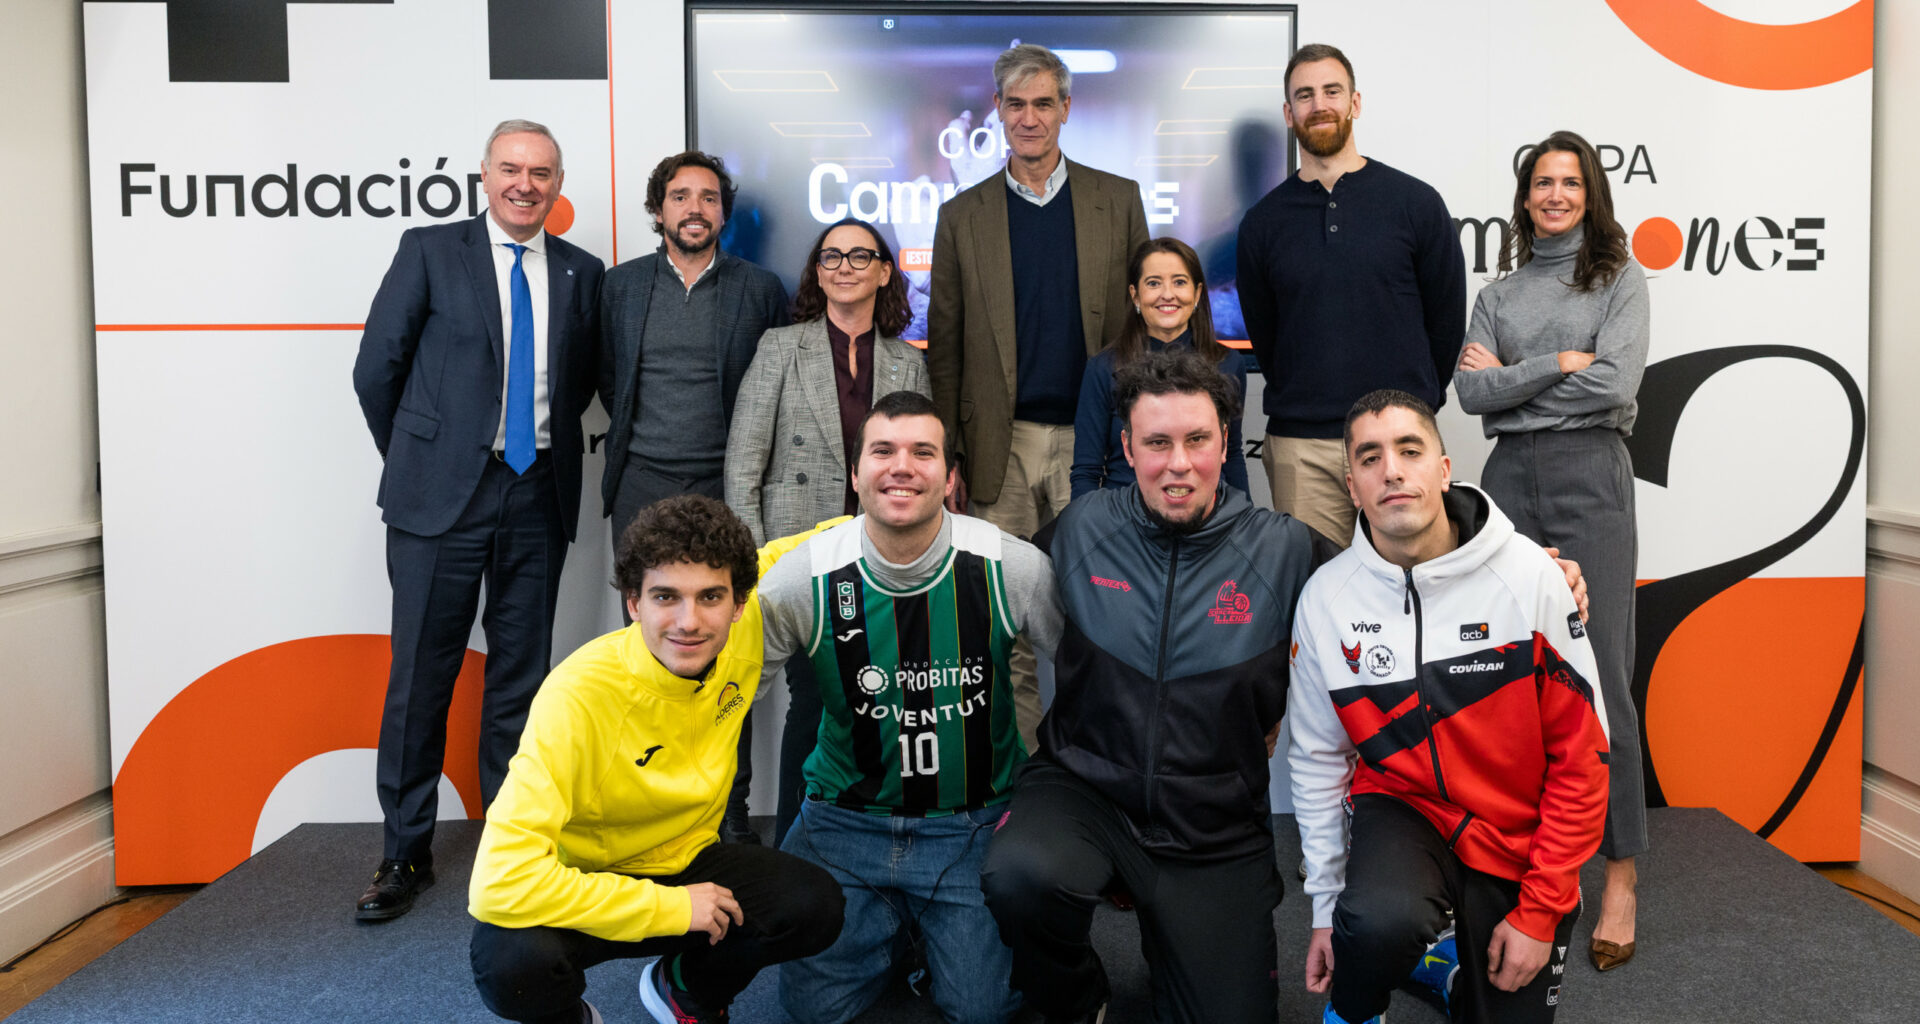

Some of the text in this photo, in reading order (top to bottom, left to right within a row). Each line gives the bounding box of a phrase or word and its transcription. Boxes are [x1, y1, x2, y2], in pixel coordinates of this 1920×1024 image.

[1350, 621, 1382, 633] vive
[1461, 630, 1483, 640] acb
[895, 665, 984, 692] PROBITAS
[855, 690, 986, 727] JOVENTUT
[898, 731, 940, 778] 10
